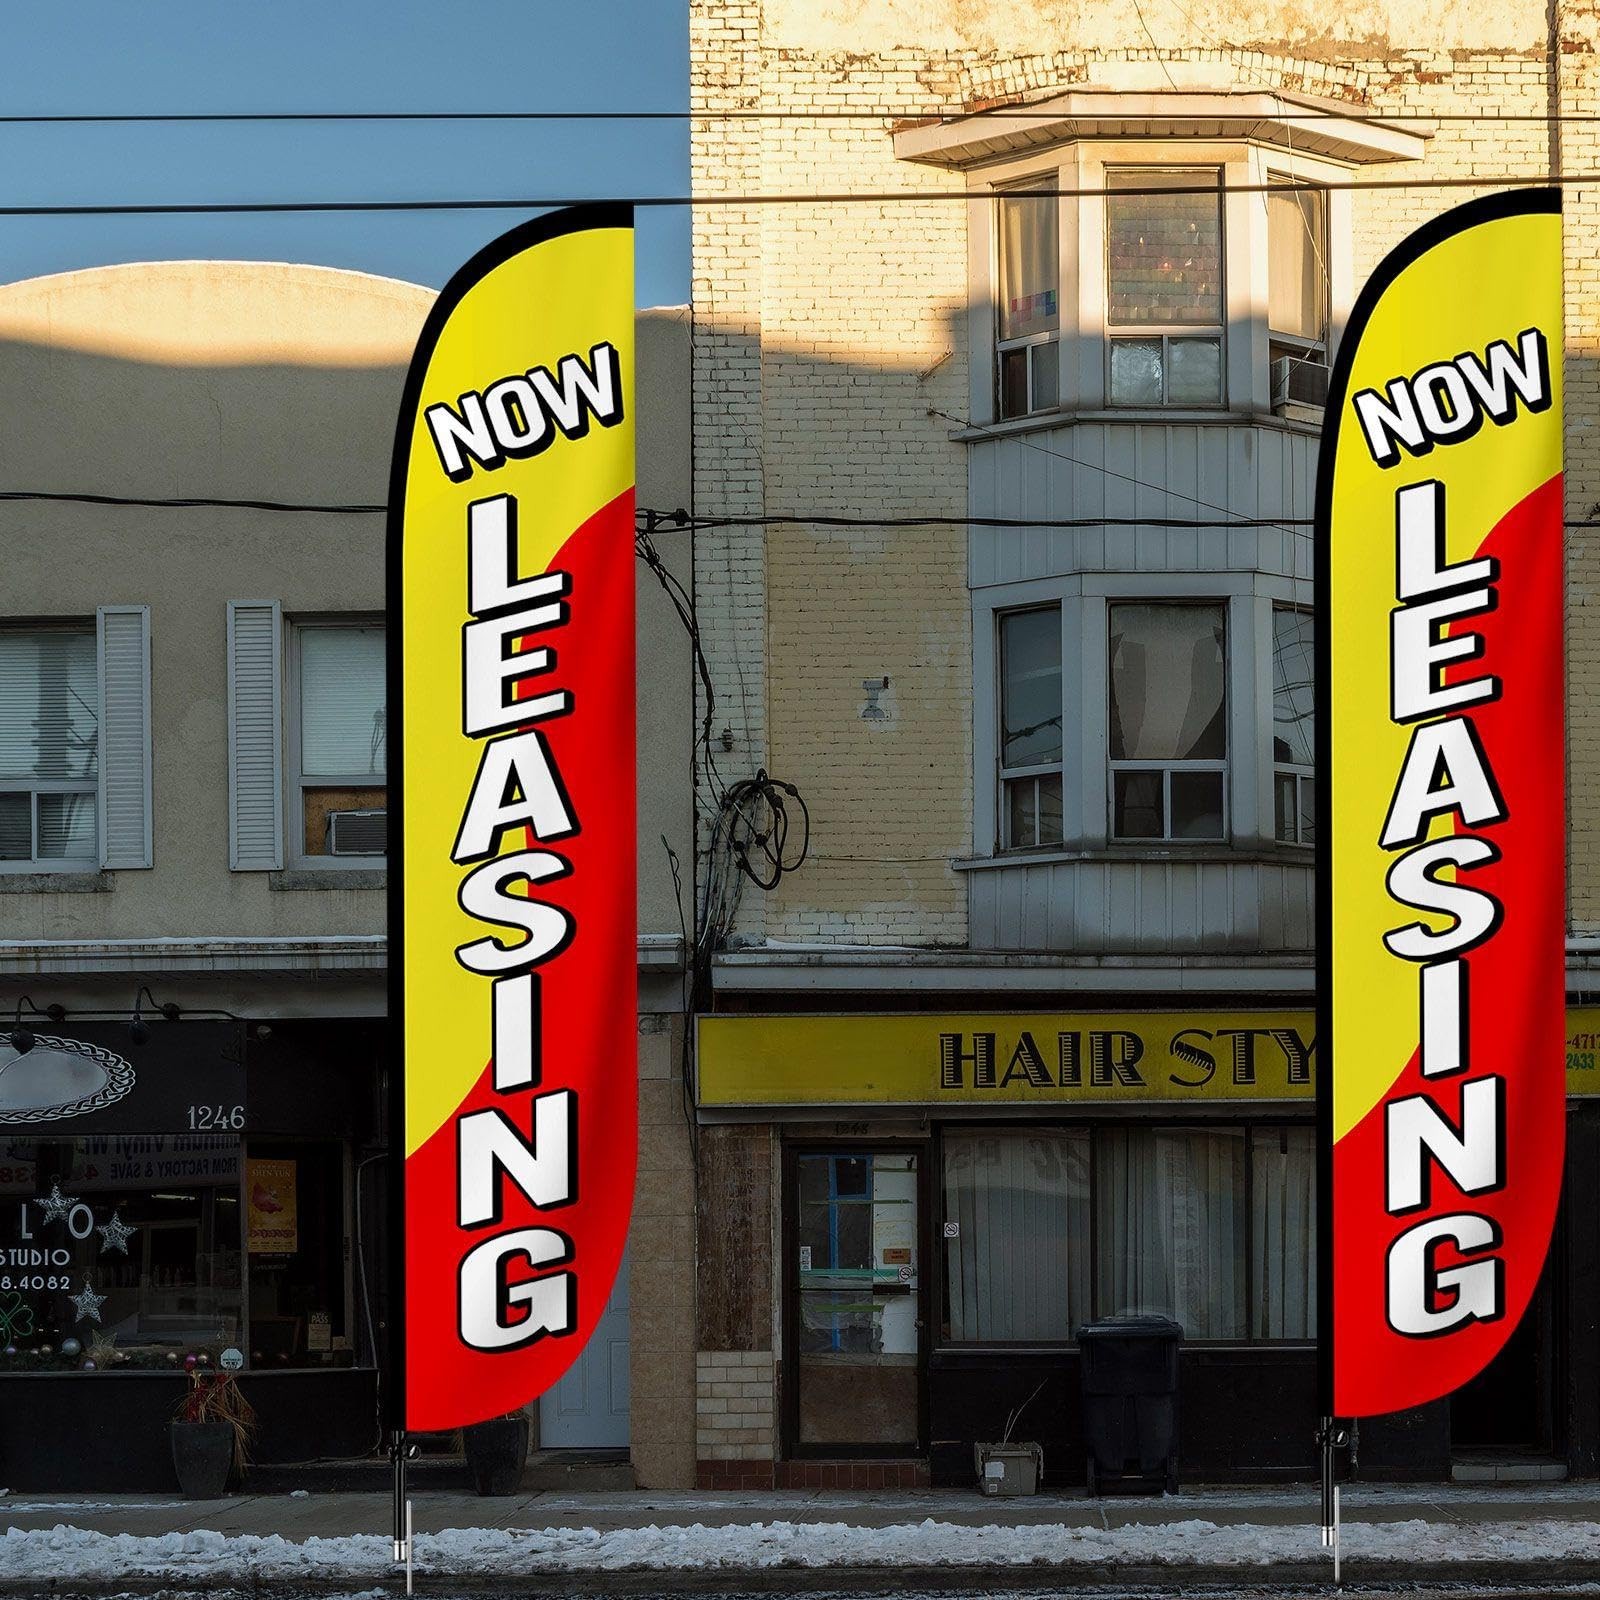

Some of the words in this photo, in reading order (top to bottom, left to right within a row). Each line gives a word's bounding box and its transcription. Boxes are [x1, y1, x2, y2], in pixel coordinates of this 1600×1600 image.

[425, 342, 623, 482] NOW
[1353, 328, 1551, 468] NOW
[452, 495, 578, 1352] LEASING
[1380, 481, 1506, 1338] LEASING
[187, 1105, 245, 1129] 1246
[940, 1031, 1147, 1088] HAIR
